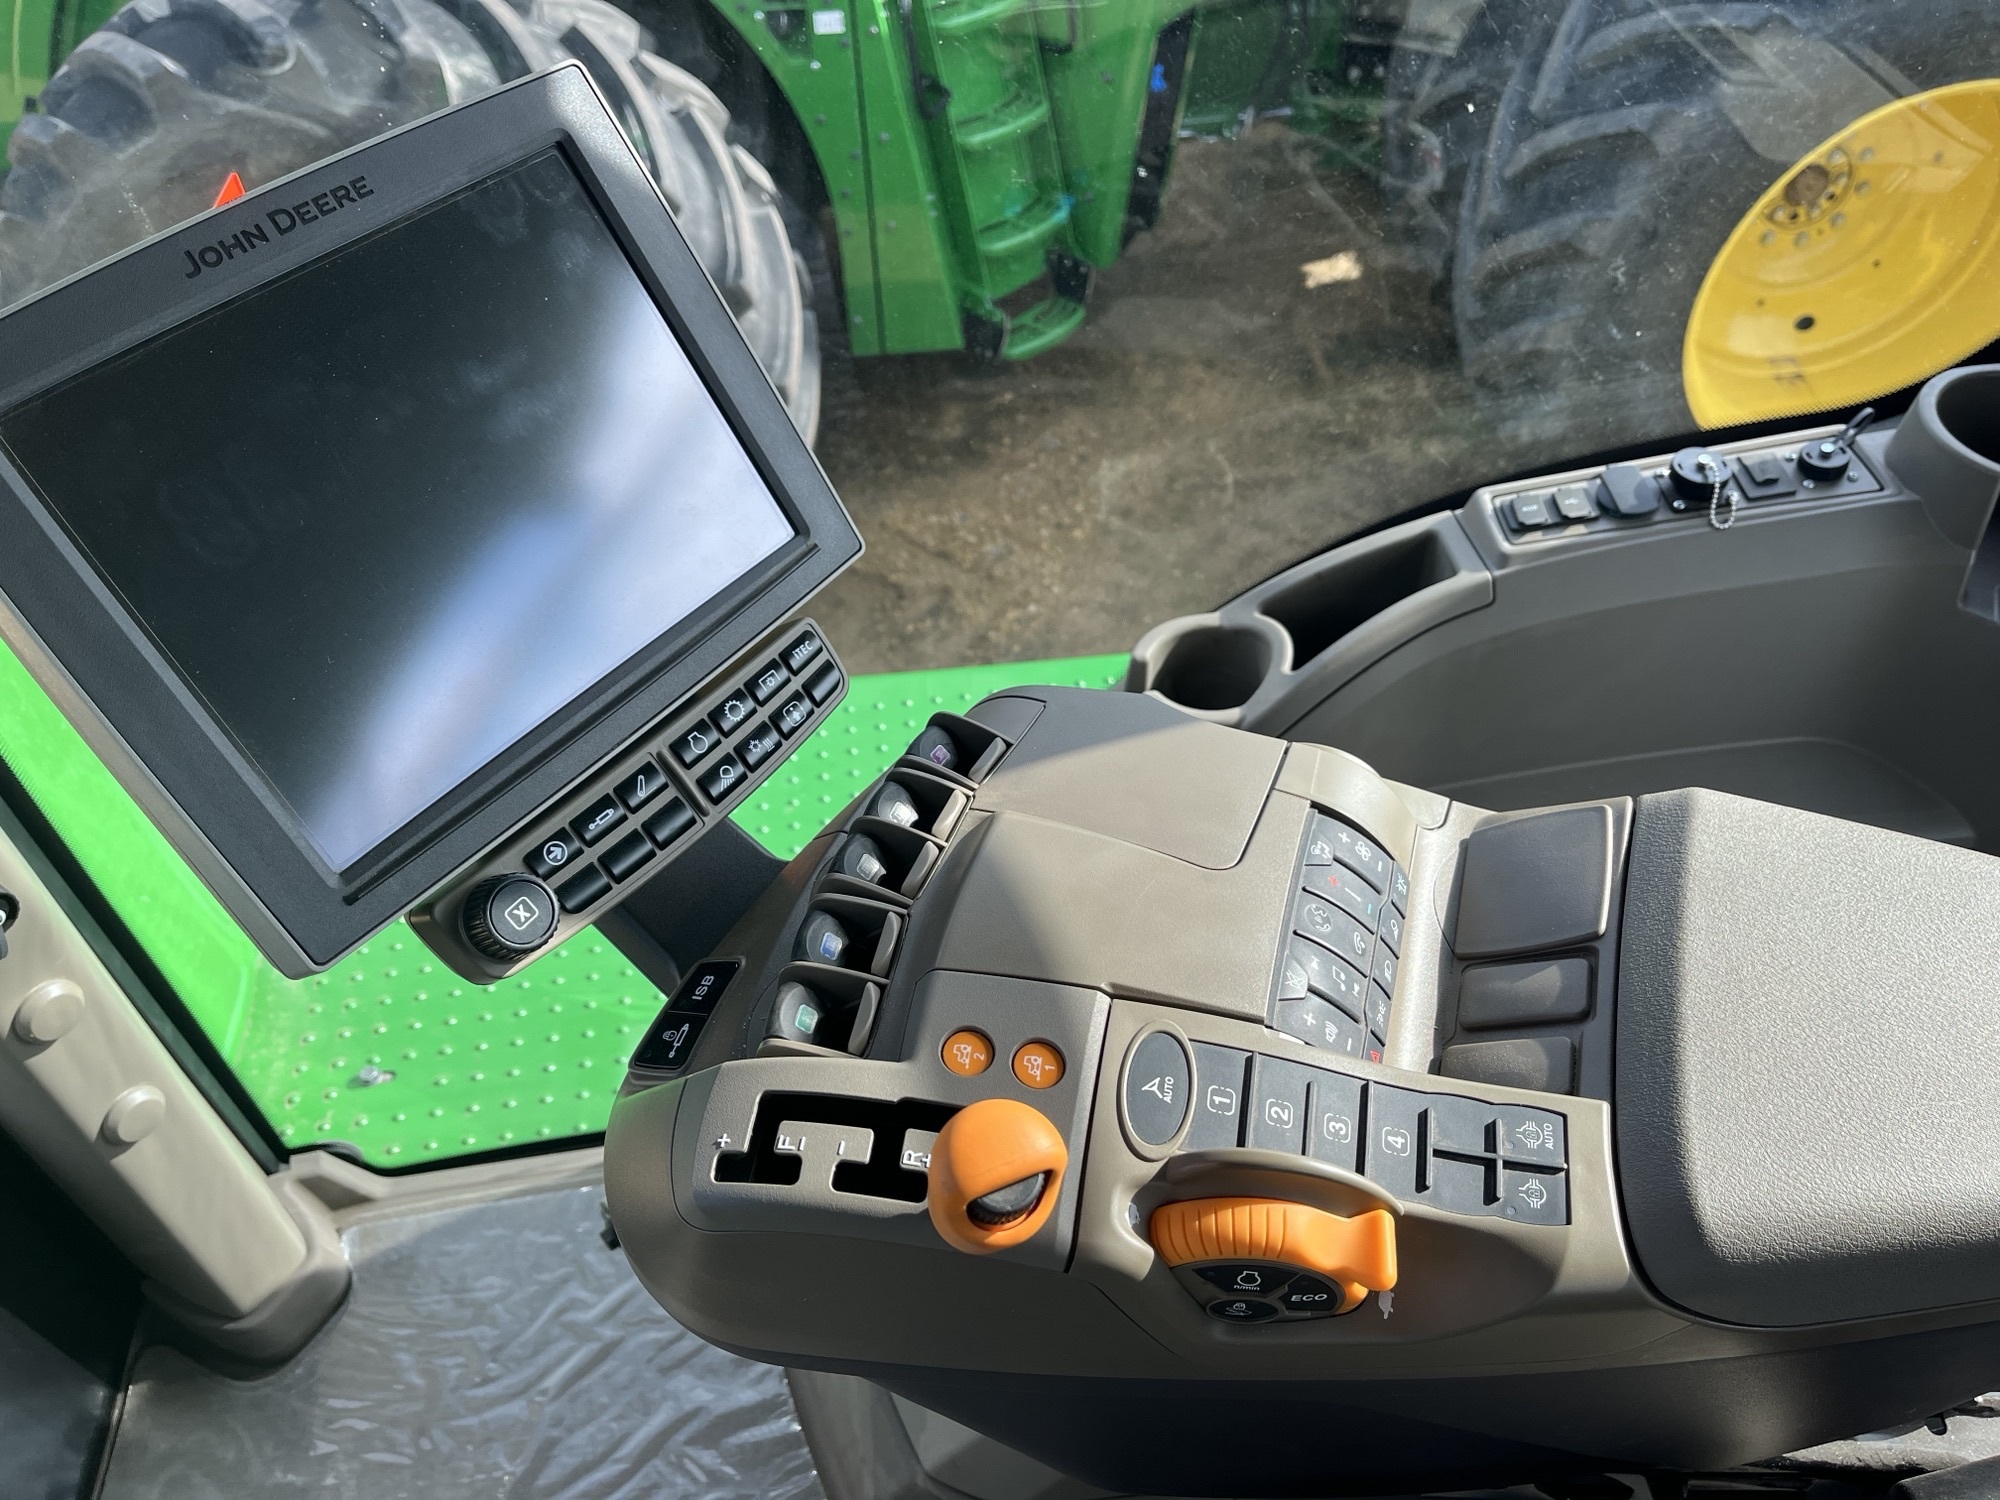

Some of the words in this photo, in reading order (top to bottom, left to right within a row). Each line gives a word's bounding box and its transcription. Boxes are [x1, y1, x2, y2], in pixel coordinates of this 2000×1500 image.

[183, 223, 270, 279] JOHN
[266, 175, 374, 236] DEERE
[792, 640, 813, 660] iTEC
[691, 975, 715, 1000] ISB
[973, 1052, 985, 1061] 2
[1163, 1076, 1175, 1104] AUTO
[1212, 1094, 1231, 1104] 1
[1270, 1107, 1289, 1121] 2
[1328, 1122, 1346, 1135] 3
[1544, 1123, 1555, 1150] AUTO
[777, 1134, 795, 1151] F
[1386, 1134, 1406, 1149] 4
[903, 1150, 923, 1167] R
[1290, 1293, 1328, 1302] ECO
